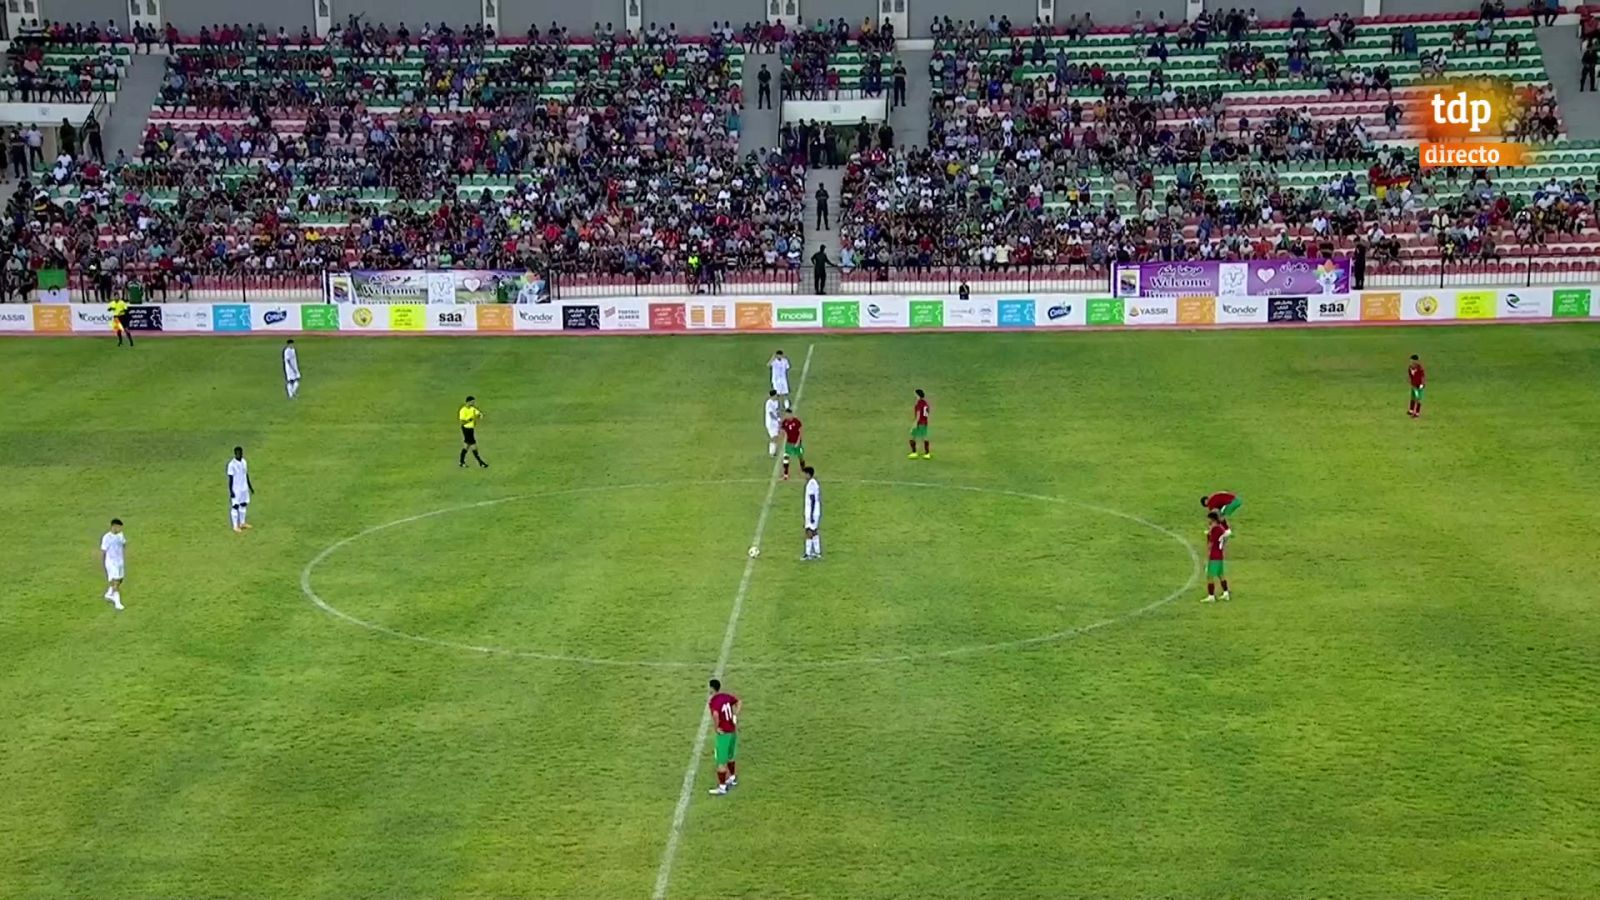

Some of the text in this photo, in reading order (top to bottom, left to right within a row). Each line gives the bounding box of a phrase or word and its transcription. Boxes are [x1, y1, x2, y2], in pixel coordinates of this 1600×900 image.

[1149, 276, 1211, 289] Welcome
[360, 284, 420, 297] Welcome
[1139, 307, 1169, 315] YASSIR
[1223, 304, 1258, 314] Condor
[1319, 302, 1345, 313] saa
[439, 312, 463, 323] saa
[519, 310, 554, 321] Condor
[721, 702, 733, 721] 11
